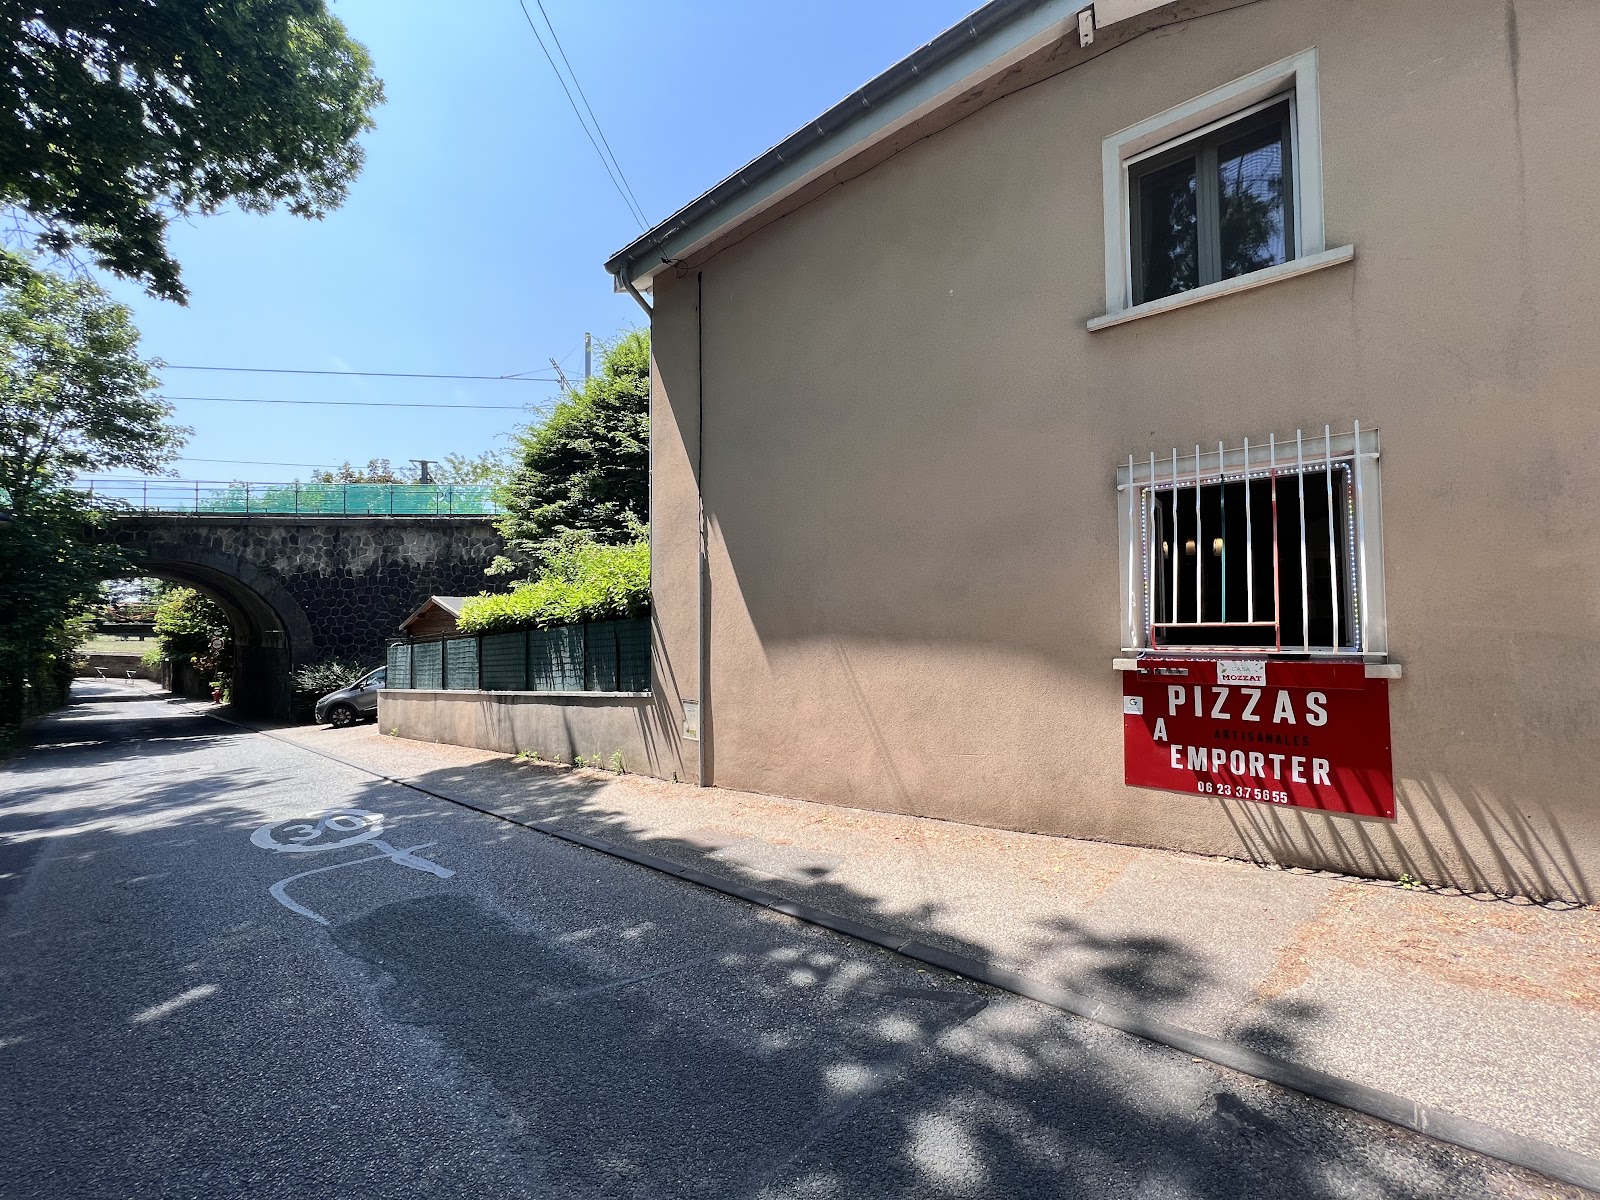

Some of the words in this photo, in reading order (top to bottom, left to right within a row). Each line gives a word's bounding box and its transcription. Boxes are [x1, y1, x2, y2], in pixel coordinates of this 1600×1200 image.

[1222, 674, 1262, 682] MOZZAT
[1168, 685, 1328, 727] PIZZAS
[1153, 717, 1168, 742] A
[1214, 729, 1310, 747] ARTISANALES
[1170, 744, 1331, 786] EMPORTER
[1197, 781, 1213, 793] 06
[1216, 783, 1232, 796] 23
[1235, 786, 1252, 799] 37
[1254, 788, 1270, 801] 56
[1272, 790, 1288, 803] 55
[283, 815, 367, 841] 30
